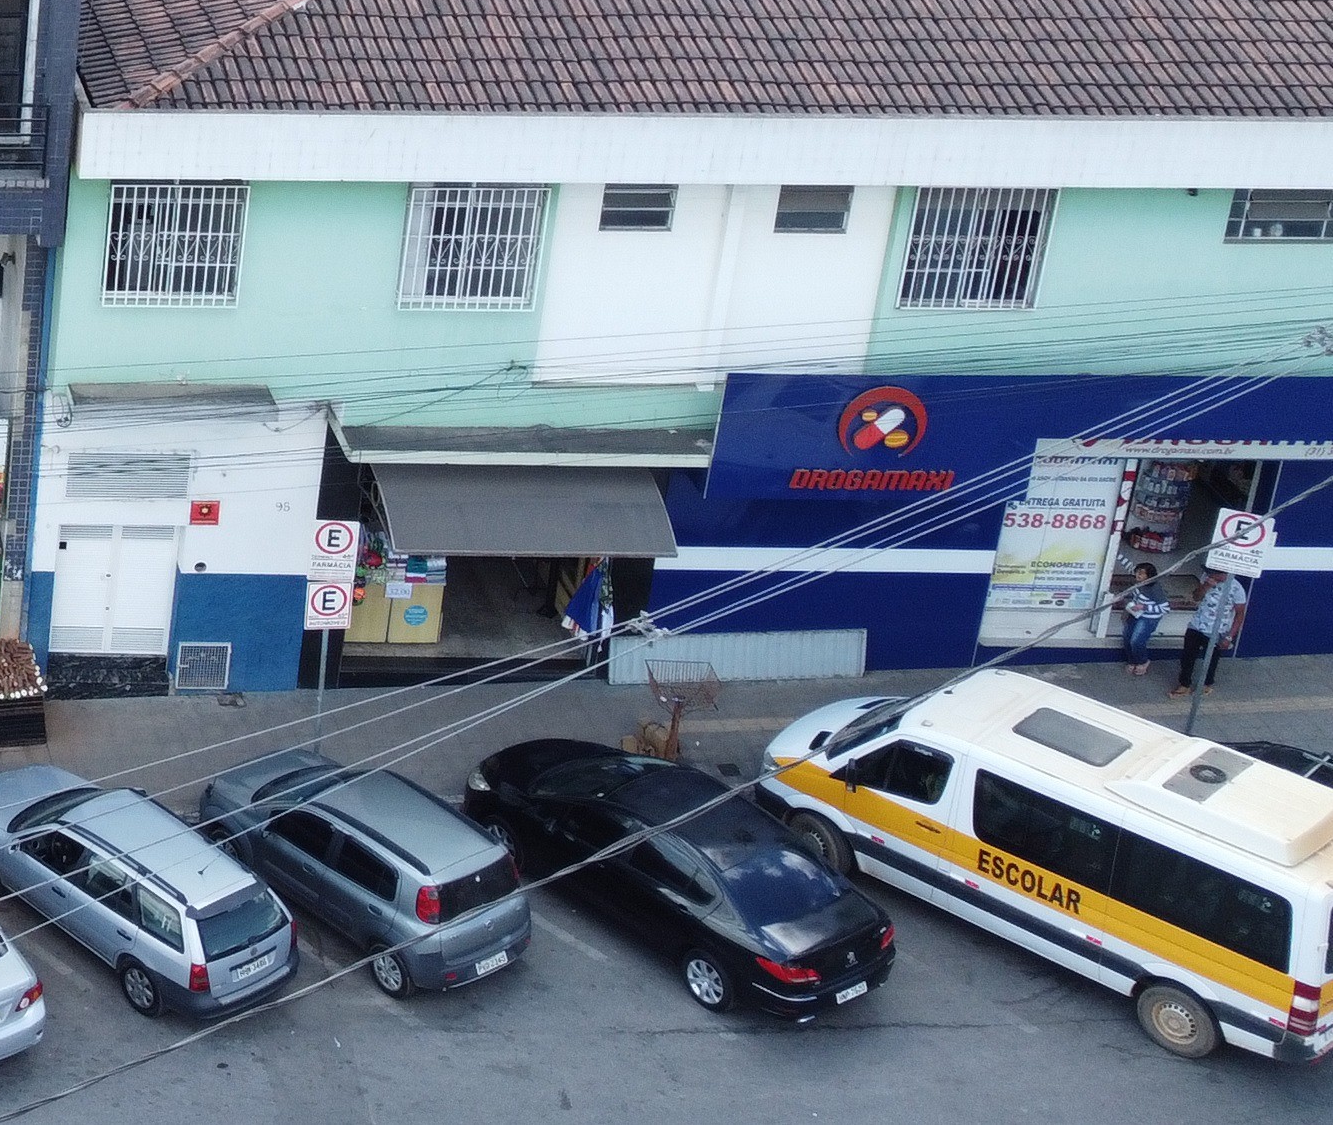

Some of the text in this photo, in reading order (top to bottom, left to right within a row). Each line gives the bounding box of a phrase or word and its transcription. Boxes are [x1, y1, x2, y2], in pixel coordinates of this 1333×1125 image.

[789, 468, 955, 491] DROGAMAXI
[275, 502, 291, 512] 98
[1062, 498, 1106, 507] GRATUITA
[327, 529, 342, 548] E
[1235, 520, 1253, 541] E
[1030, 561, 1085, 569] ECONOMIZE
[322, 590, 337, 611] E
[977, 848, 1081, 915] ESCOLAR
